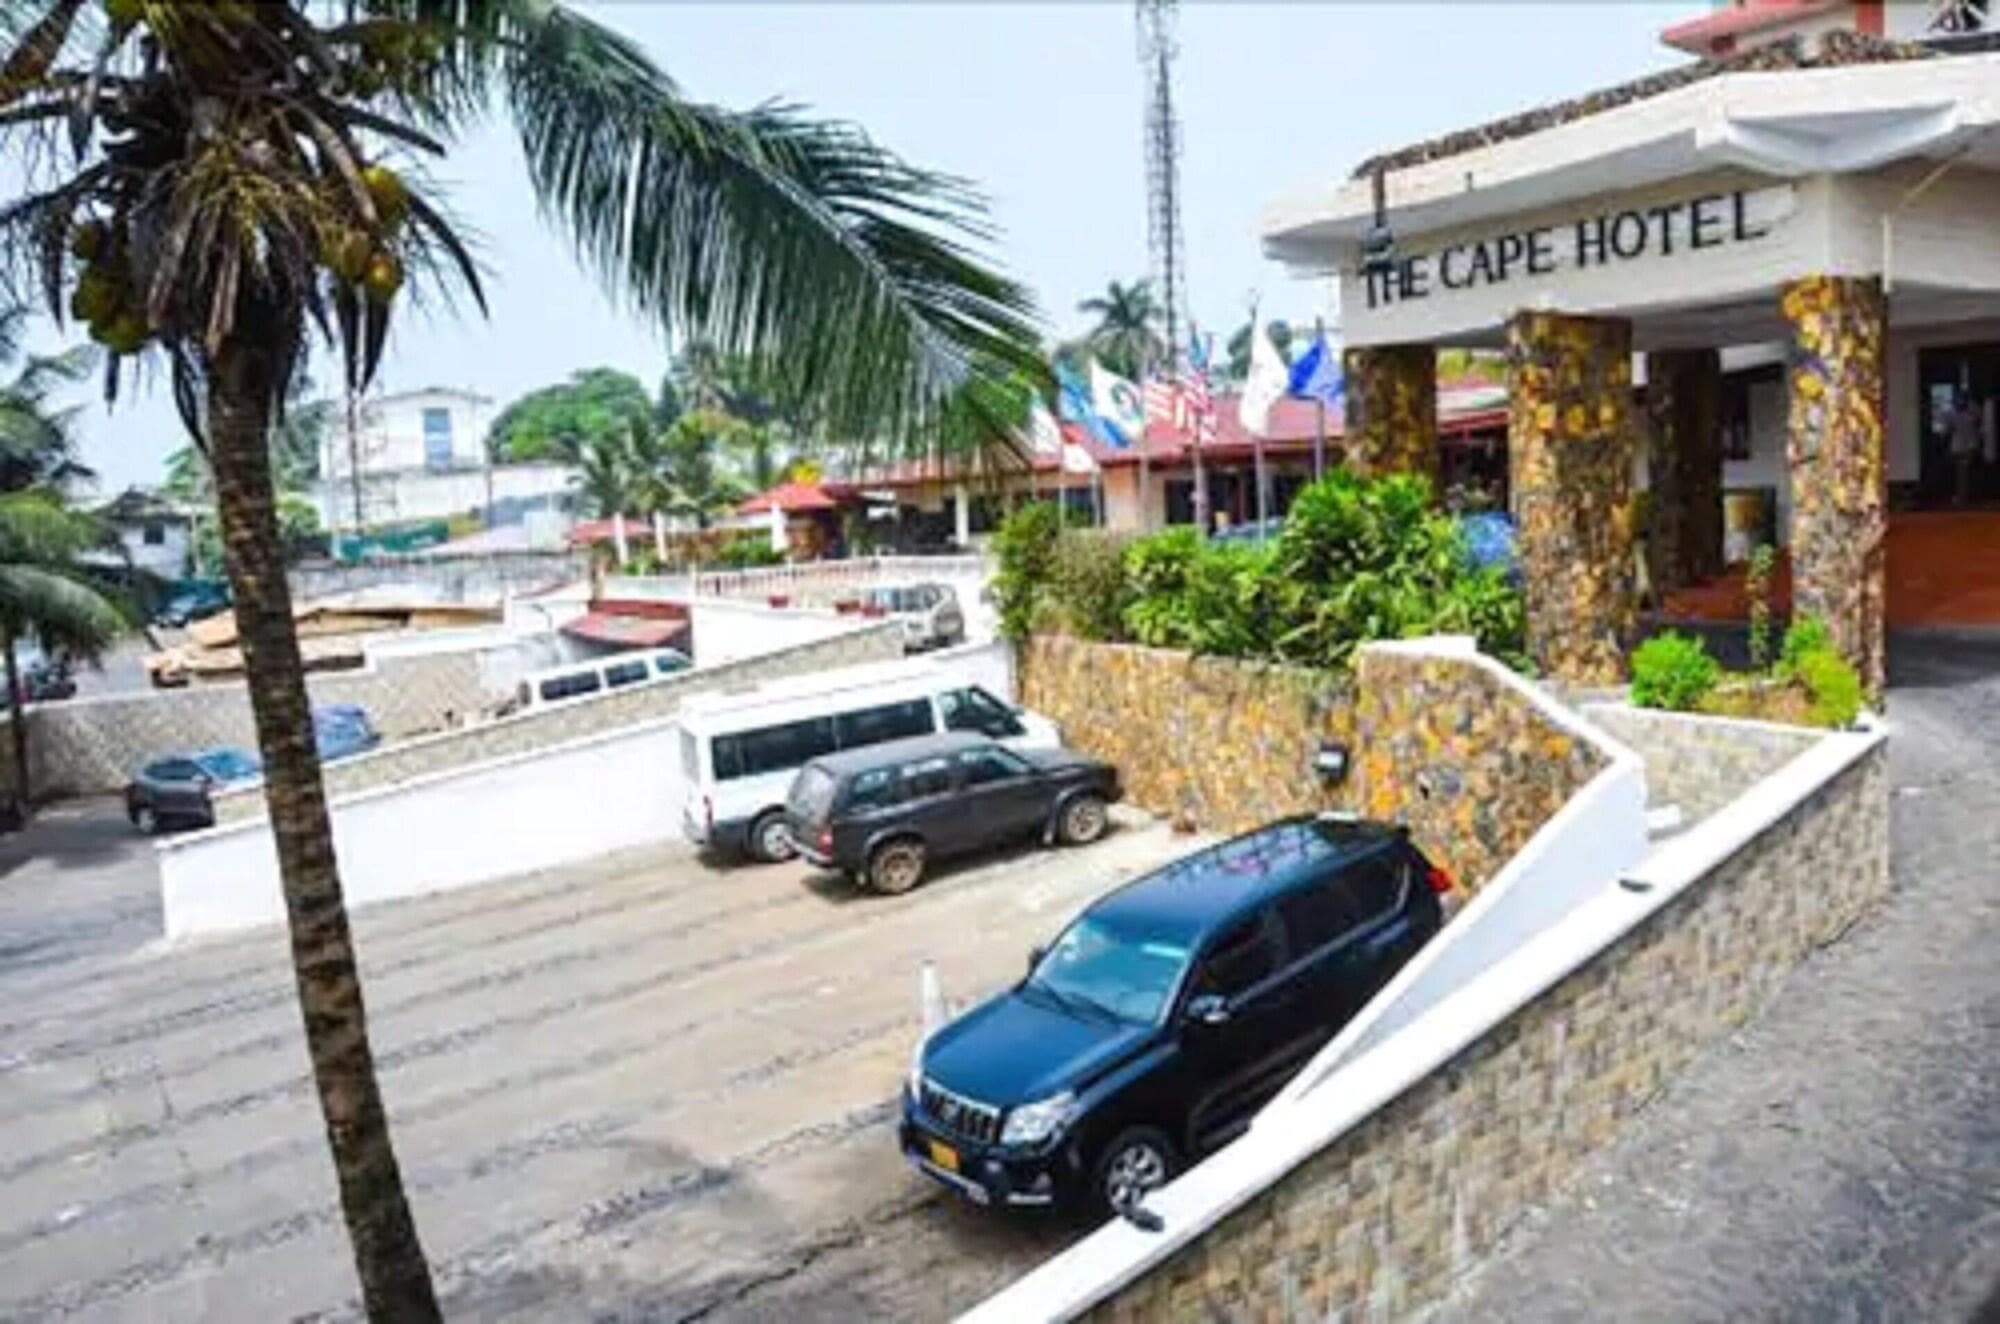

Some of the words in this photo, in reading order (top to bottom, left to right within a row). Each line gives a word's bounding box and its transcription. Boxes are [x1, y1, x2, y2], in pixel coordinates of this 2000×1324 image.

[1359, 255, 1429, 308] THE
[1440, 228, 1554, 289] CAPE
[1577, 191, 1766, 268] HOTEL
